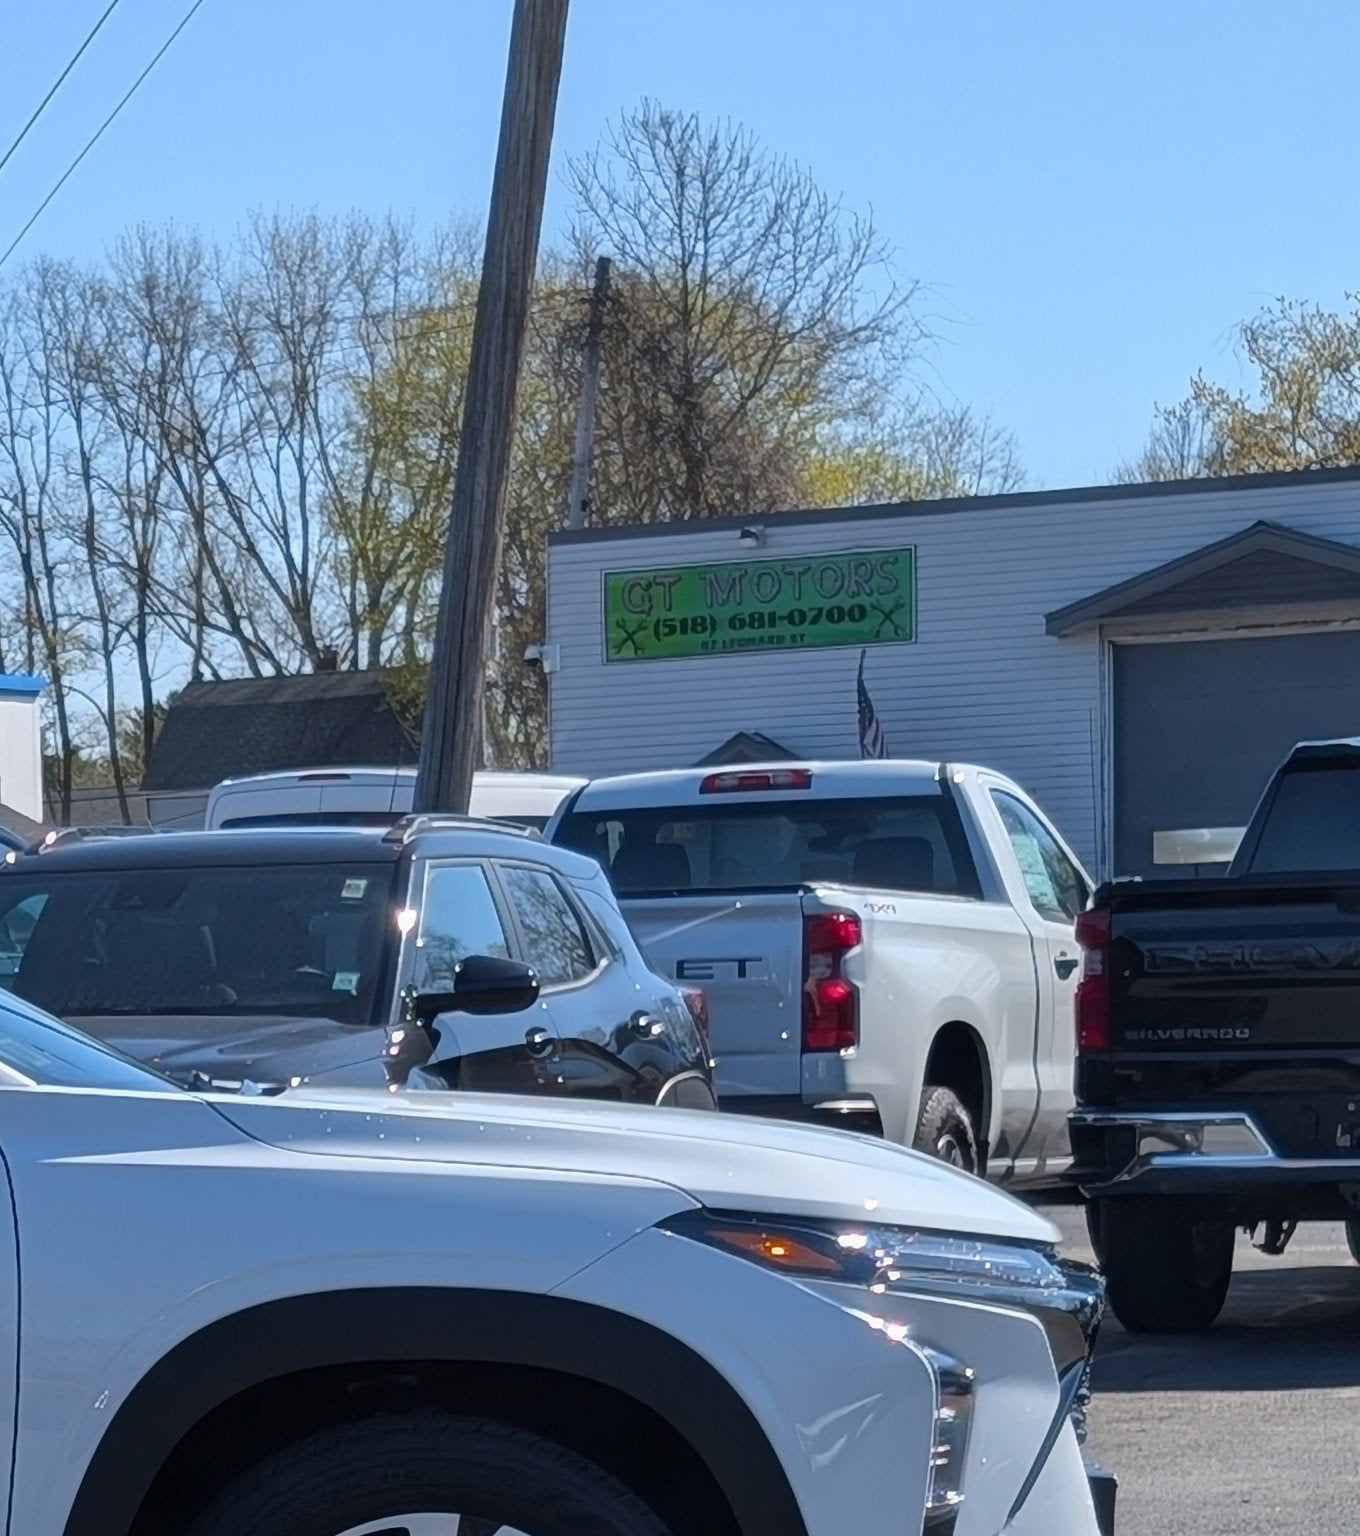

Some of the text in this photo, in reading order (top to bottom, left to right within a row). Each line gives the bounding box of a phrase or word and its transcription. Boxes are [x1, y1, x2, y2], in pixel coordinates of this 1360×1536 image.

[622, 557, 899, 616] GT MOTORS
[654, 603, 868, 643] (518) 681-0700
[1125, 1026, 1250, 1040] SILVERADO
